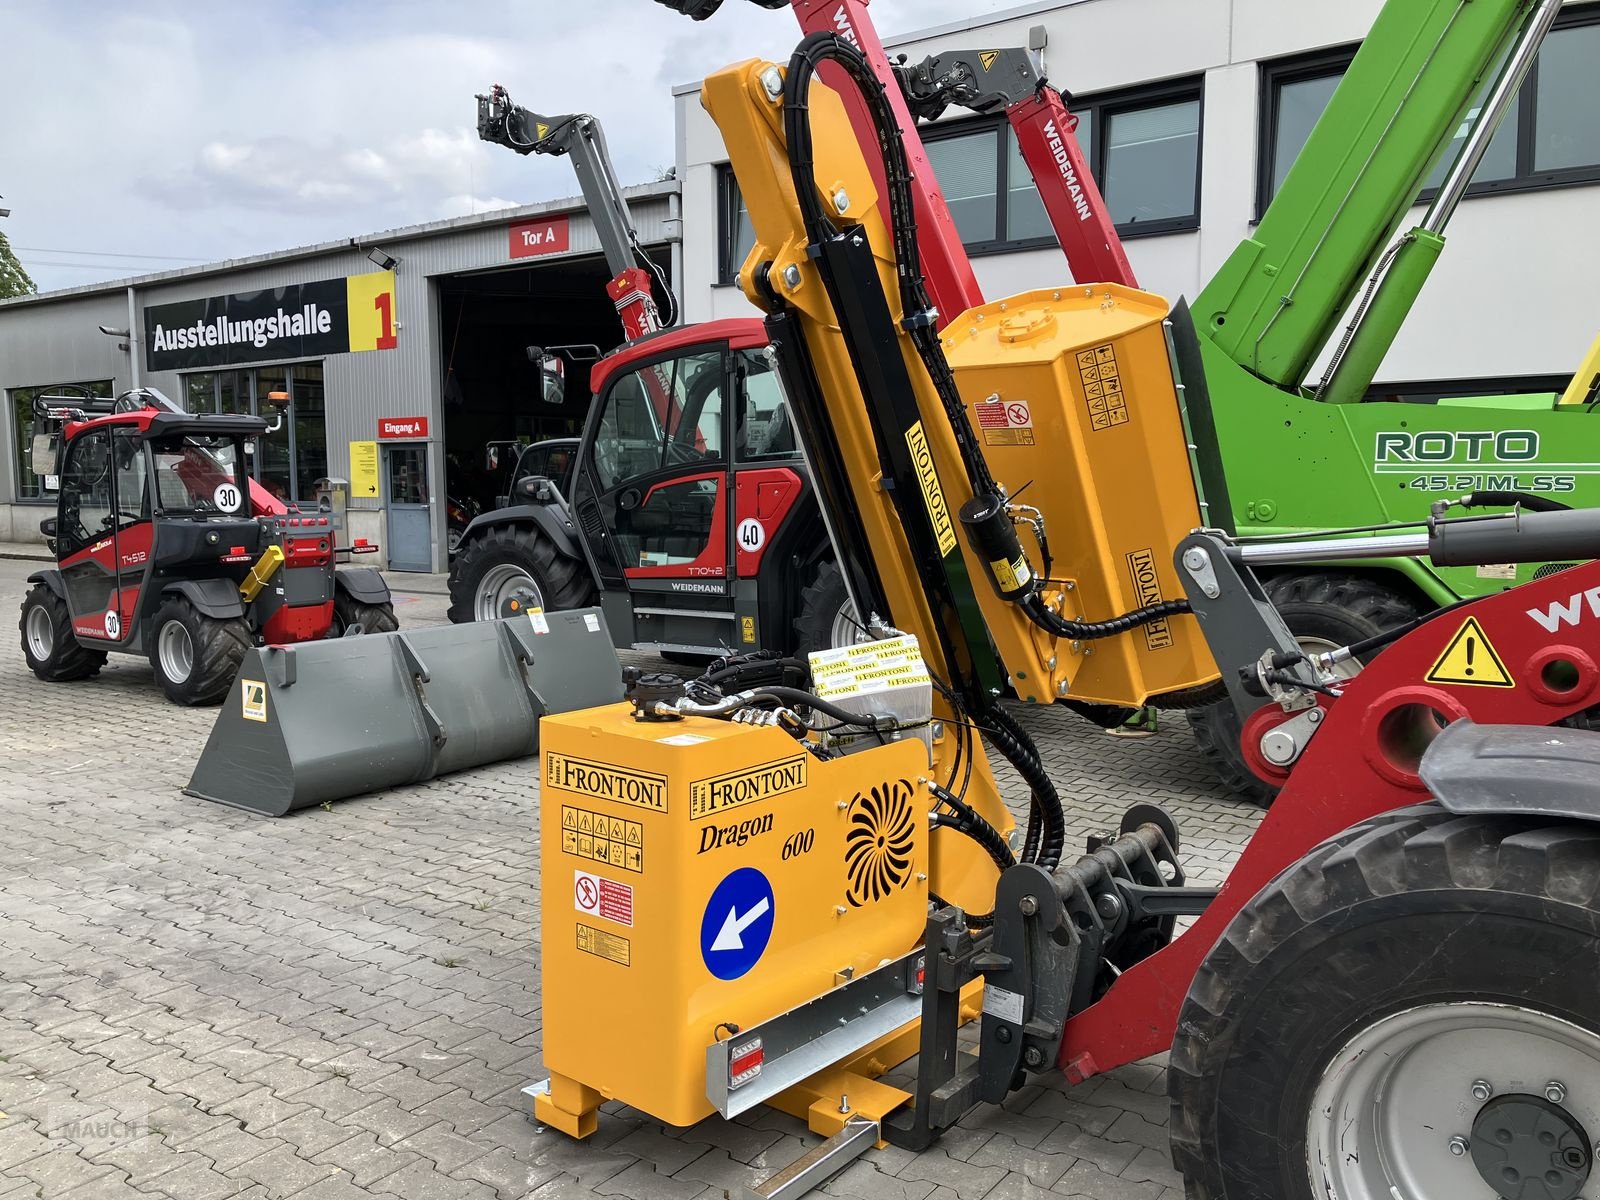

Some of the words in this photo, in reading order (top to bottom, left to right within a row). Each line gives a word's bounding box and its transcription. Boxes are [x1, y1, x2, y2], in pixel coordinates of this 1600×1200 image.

[1043, 119, 1091, 221] WEIDEMANN
[521, 230, 542, 246] Tor
[545, 226, 555, 243] A
[153, 303, 331, 351] Ausstellungshalle
[375, 292, 397, 350] 1
[384, 423, 413, 434] Eingang
[414, 422, 421, 431] A
[1375, 429, 1540, 461] ROTO
[907, 425, 951, 537] FRONTONI
[1410, 475, 1484, 491] 45.21
[220, 489, 236, 507] 30
[742, 525, 759, 546] 40
[687, 567, 723, 576] T7042
[671, 583, 724, 593] WEIDEMANN
[1130, 553, 1168, 637] FNTONI
[108, 616, 117, 633] 30
[563, 759, 665, 807] FRONTONI
[708, 757, 805, 810] FRONTONI
[697, 813, 774, 855] Dragon
[781, 828, 815, 860] 600
